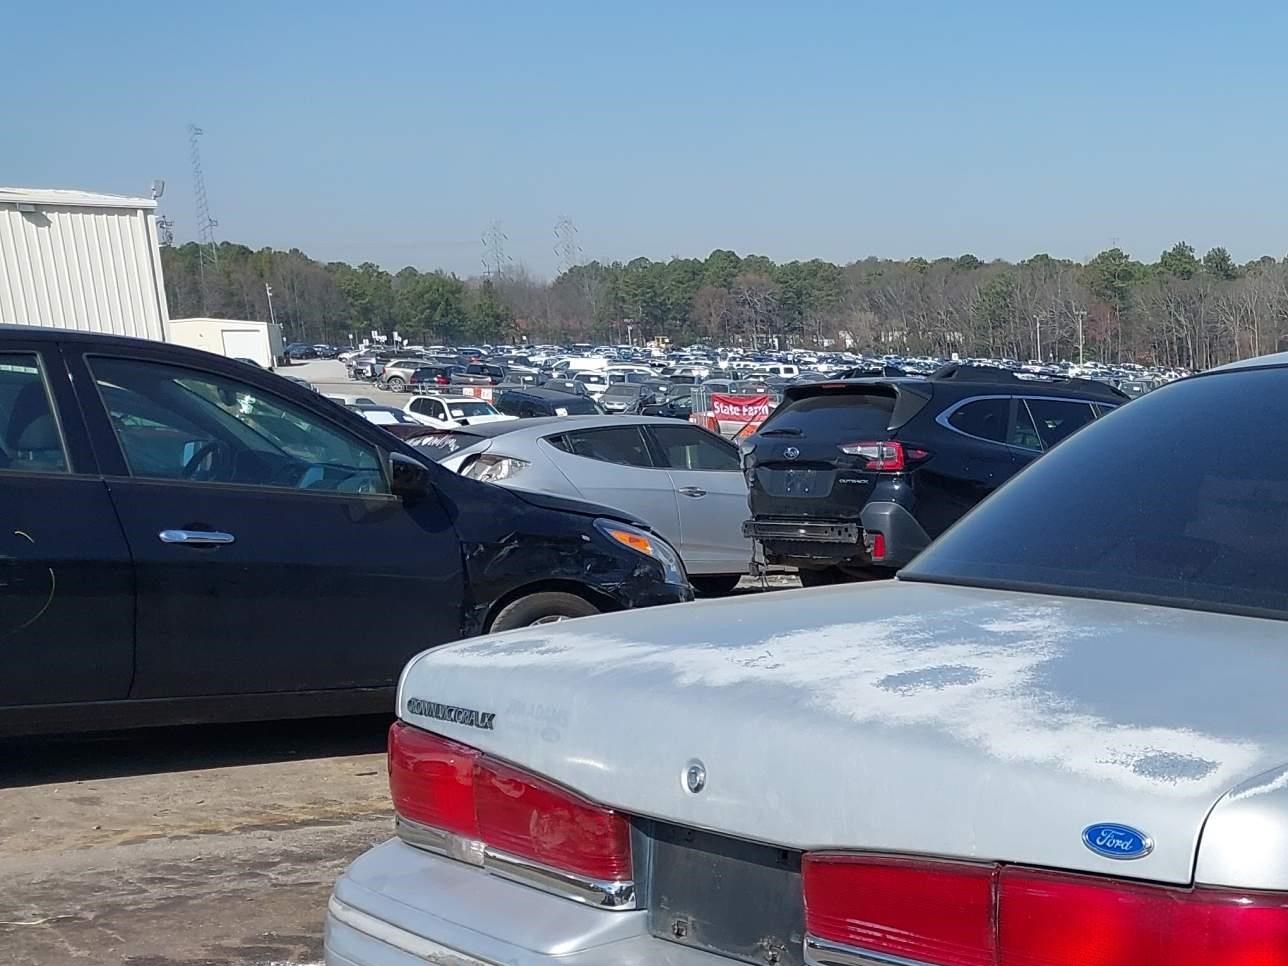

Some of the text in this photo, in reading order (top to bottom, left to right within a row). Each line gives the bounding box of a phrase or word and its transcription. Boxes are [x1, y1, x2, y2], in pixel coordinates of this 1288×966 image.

[713, 401, 769, 417] State Farm
[1096, 828, 1134, 851] Ford
